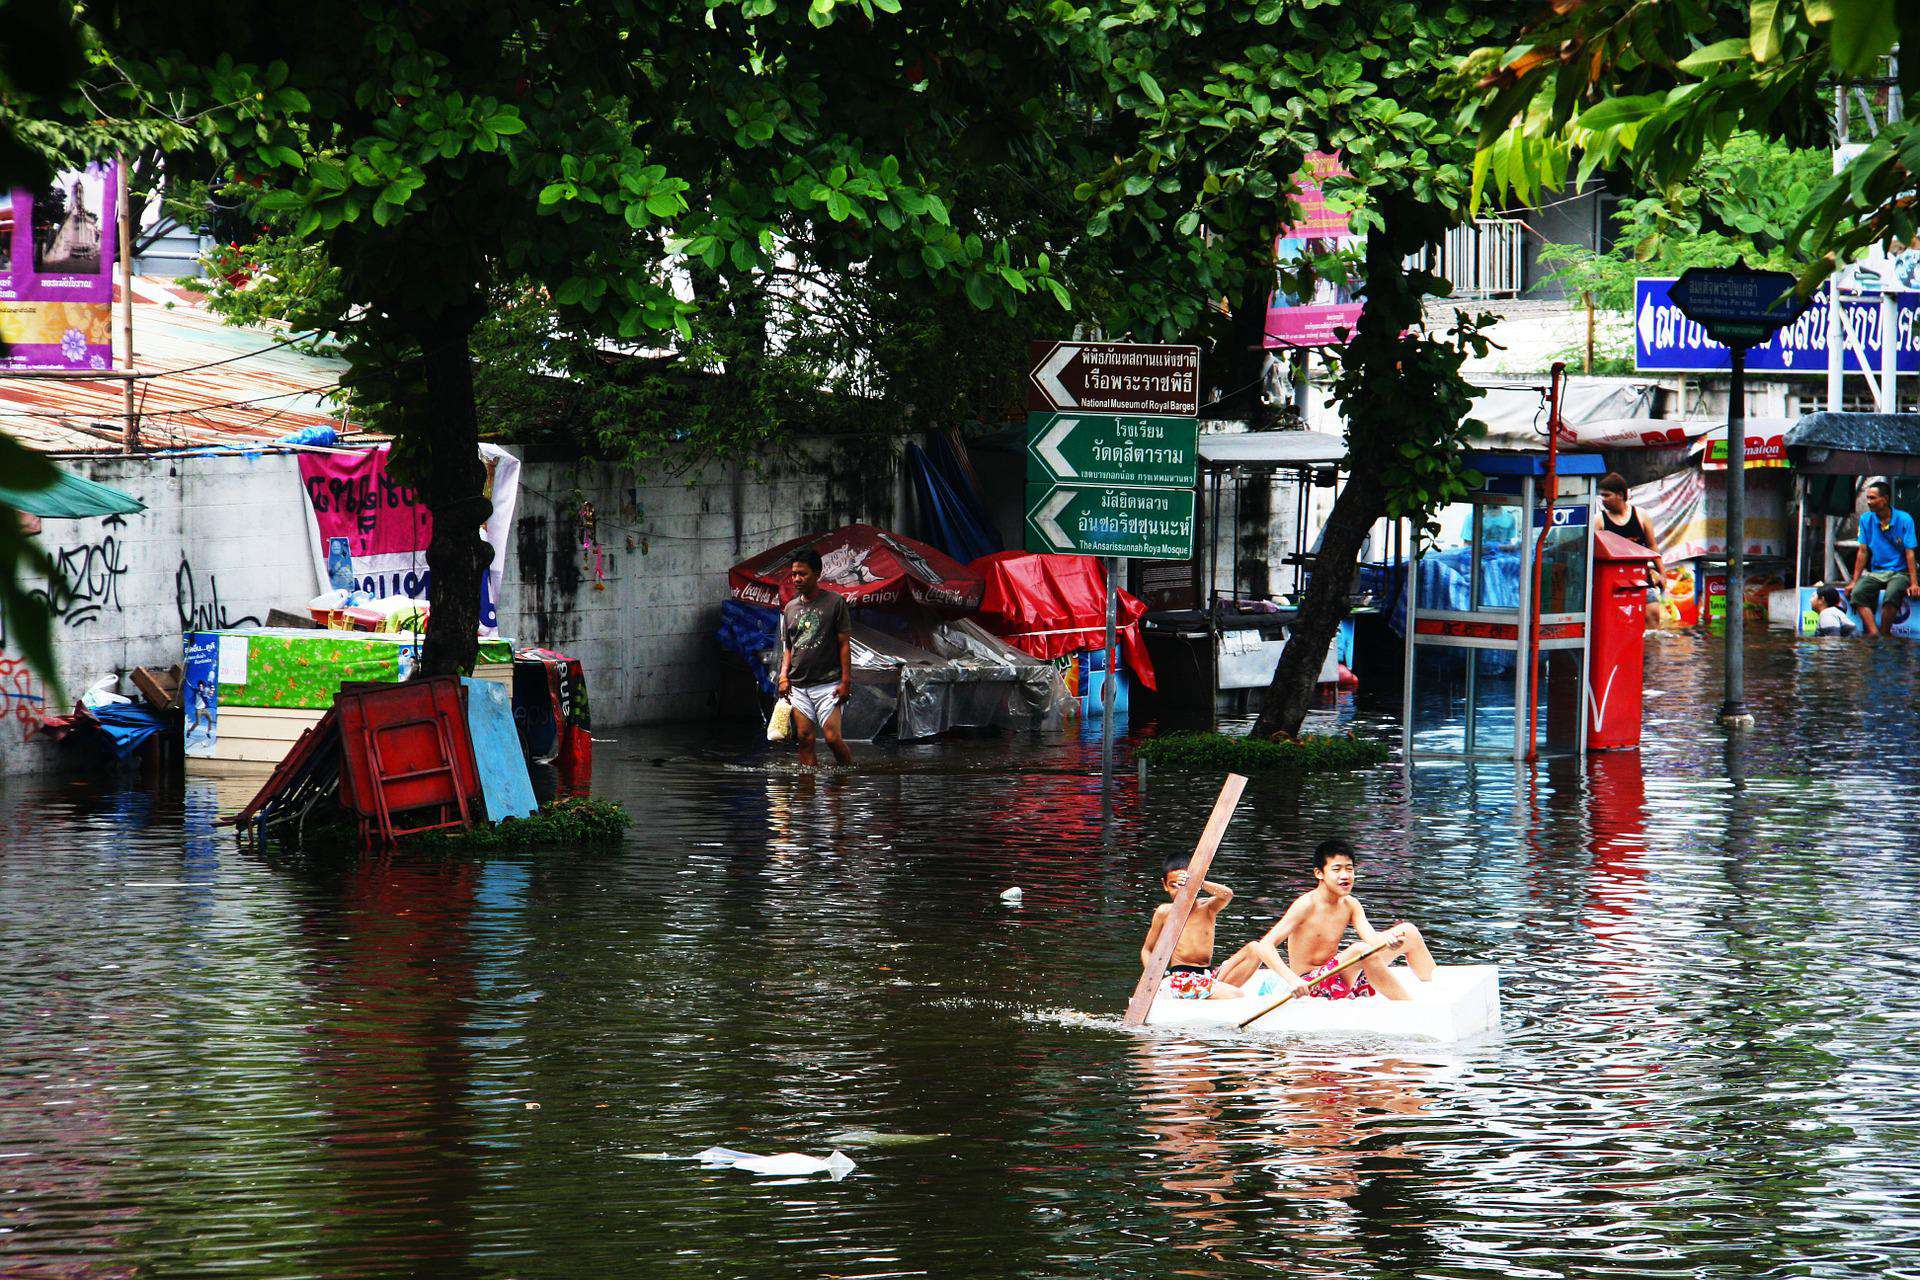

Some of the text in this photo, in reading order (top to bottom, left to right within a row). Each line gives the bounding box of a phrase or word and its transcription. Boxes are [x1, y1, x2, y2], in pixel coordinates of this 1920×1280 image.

[1081, 346, 1197, 368] พิพิธภัณฑสถานแห่งชาติ
[1084, 367, 1193, 393] เรือพระราชพิธี
[1081, 397, 1195, 412] National Museum of Royal Barges
[1114, 417, 1164, 439] โรงเรียน
[1092, 438, 1184, 468] วัดดุสิตาราม
[1101, 489, 1169, 511] มัสยิดหลวง
[1545, 508, 1575, 525] OT
[1079, 540, 1091, 550] The
[1092, 541, 1143, 552] Ansarissunnah
[1161, 544, 1189, 556] Mosque
[862, 587, 900, 604] enjoy
